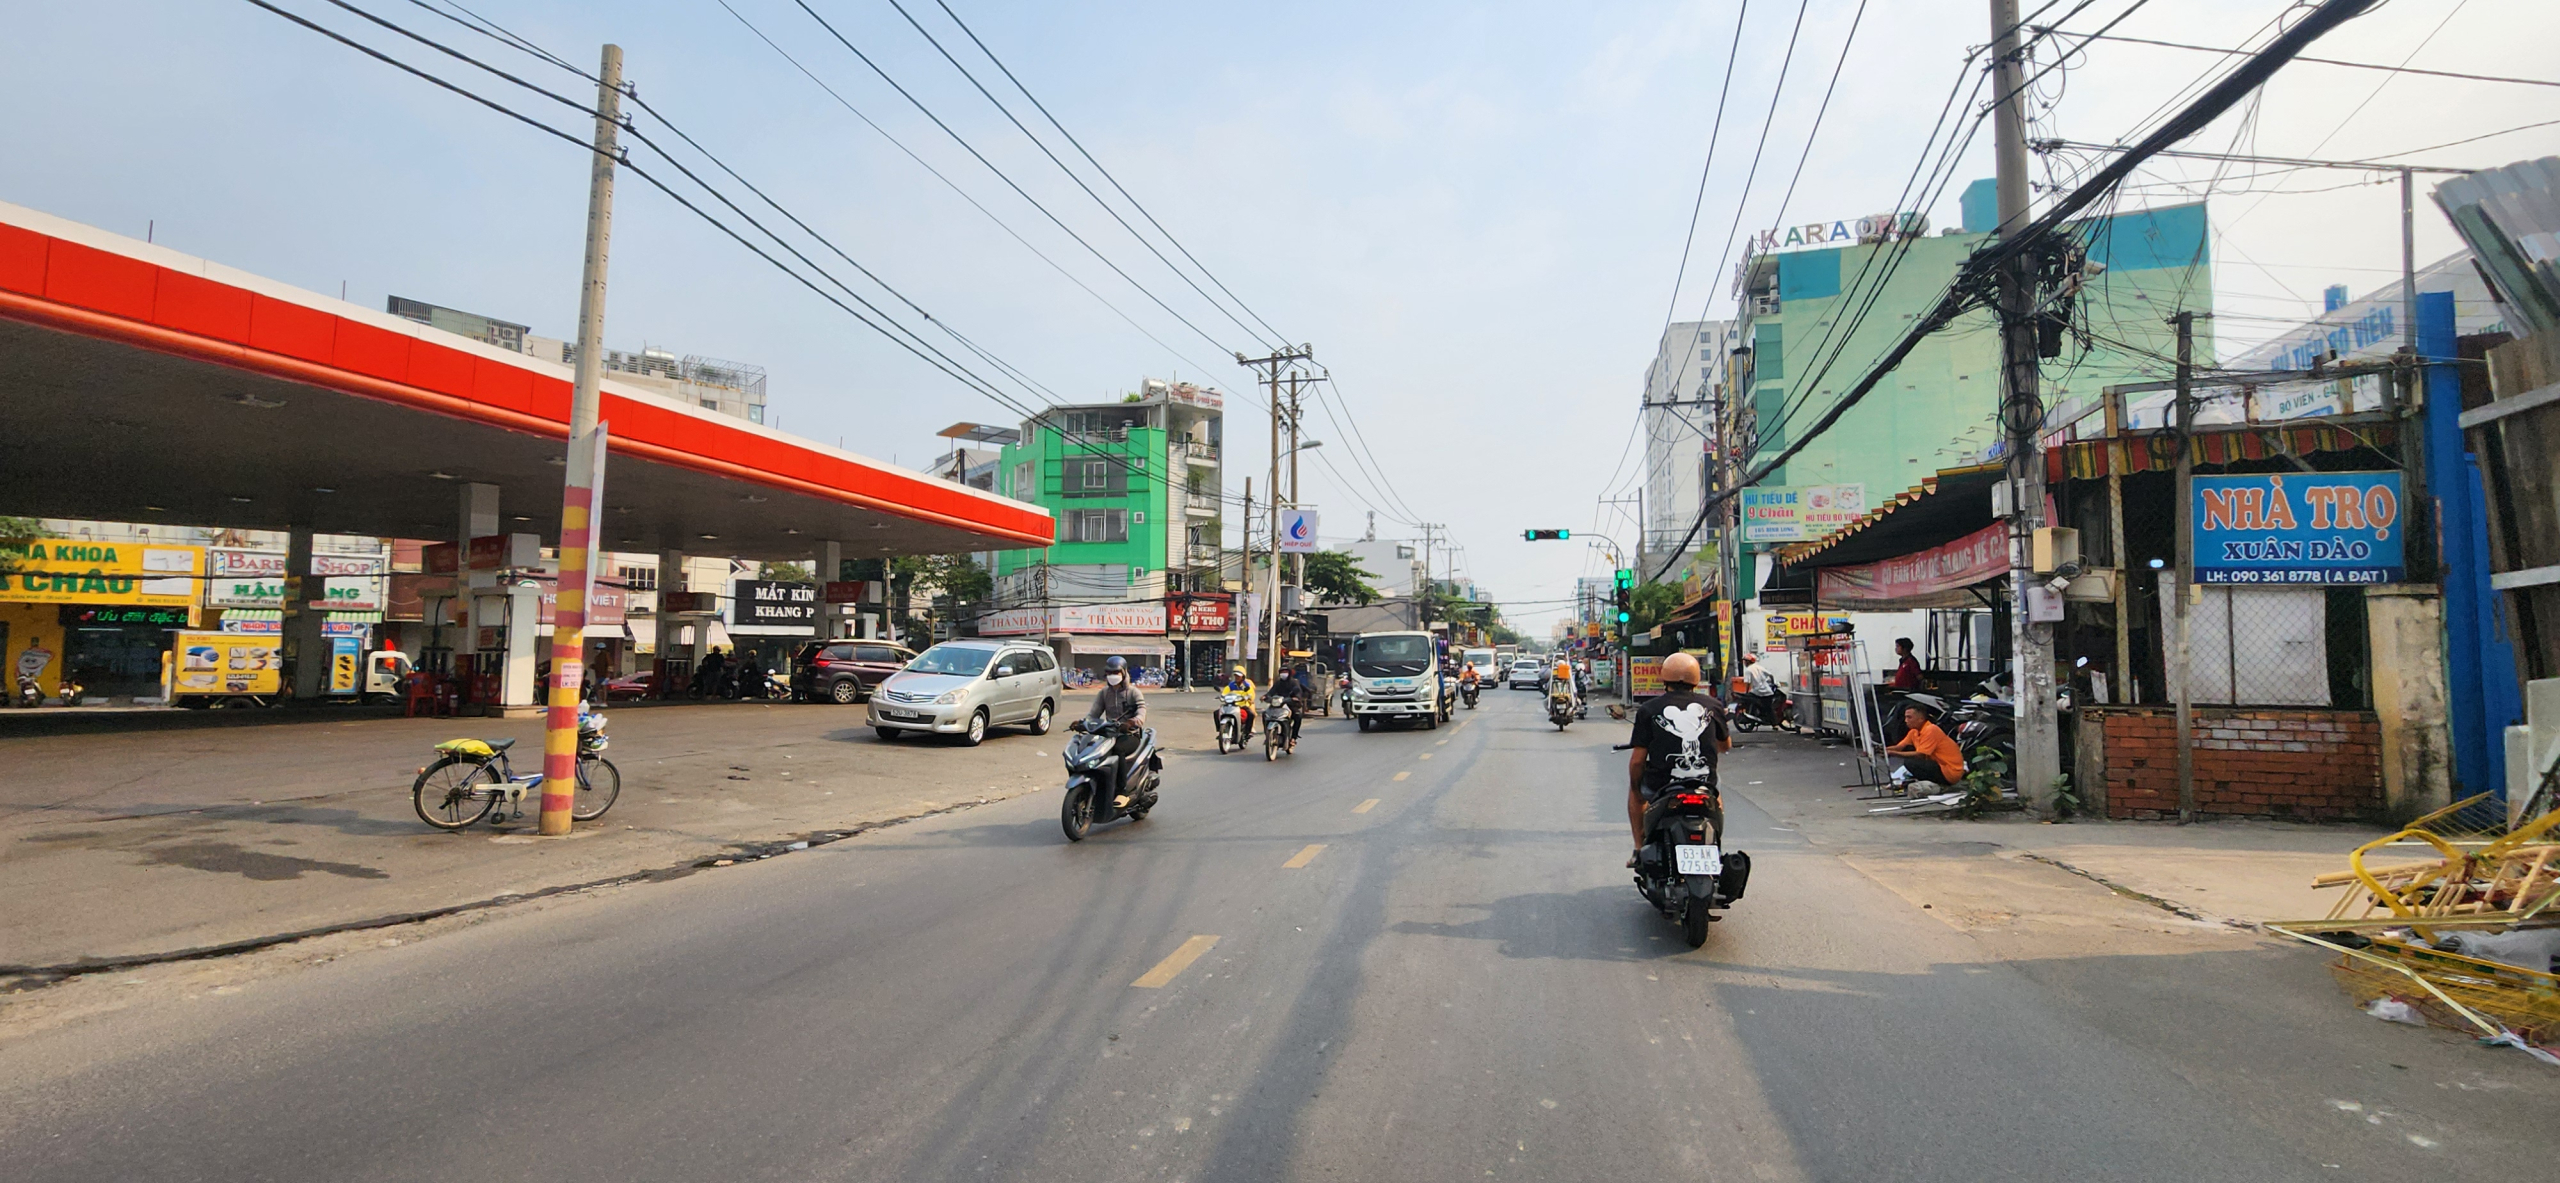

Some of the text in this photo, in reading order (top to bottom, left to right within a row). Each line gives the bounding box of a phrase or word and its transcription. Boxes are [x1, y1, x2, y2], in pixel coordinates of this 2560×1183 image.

[1748, 507, 1755, 518] 9
[2201, 474, 2397, 541] NHÀ TRỌ
[55, 545, 118, 562] KHOA
[2222, 535, 2371, 560] XUÂN ĐÀO
[227, 552, 370, 574] BARB SHOP
[23, 569, 133, 593] CHÂU
[2206, 571, 2227, 582] LH:
[2231, 571, 2259, 582] 090
[2262, 571, 2285, 582] 361
[2288, 571, 2321, 582] 8778
[755, 582, 814, 601] MẮT KÍN
[755, 605, 802, 618] KHANG
[1087, 612, 1163, 628] THÀNH ĐẠT
[1790, 617, 1825, 632] CHAY
[1680, 860, 1718, 872] 275.65
